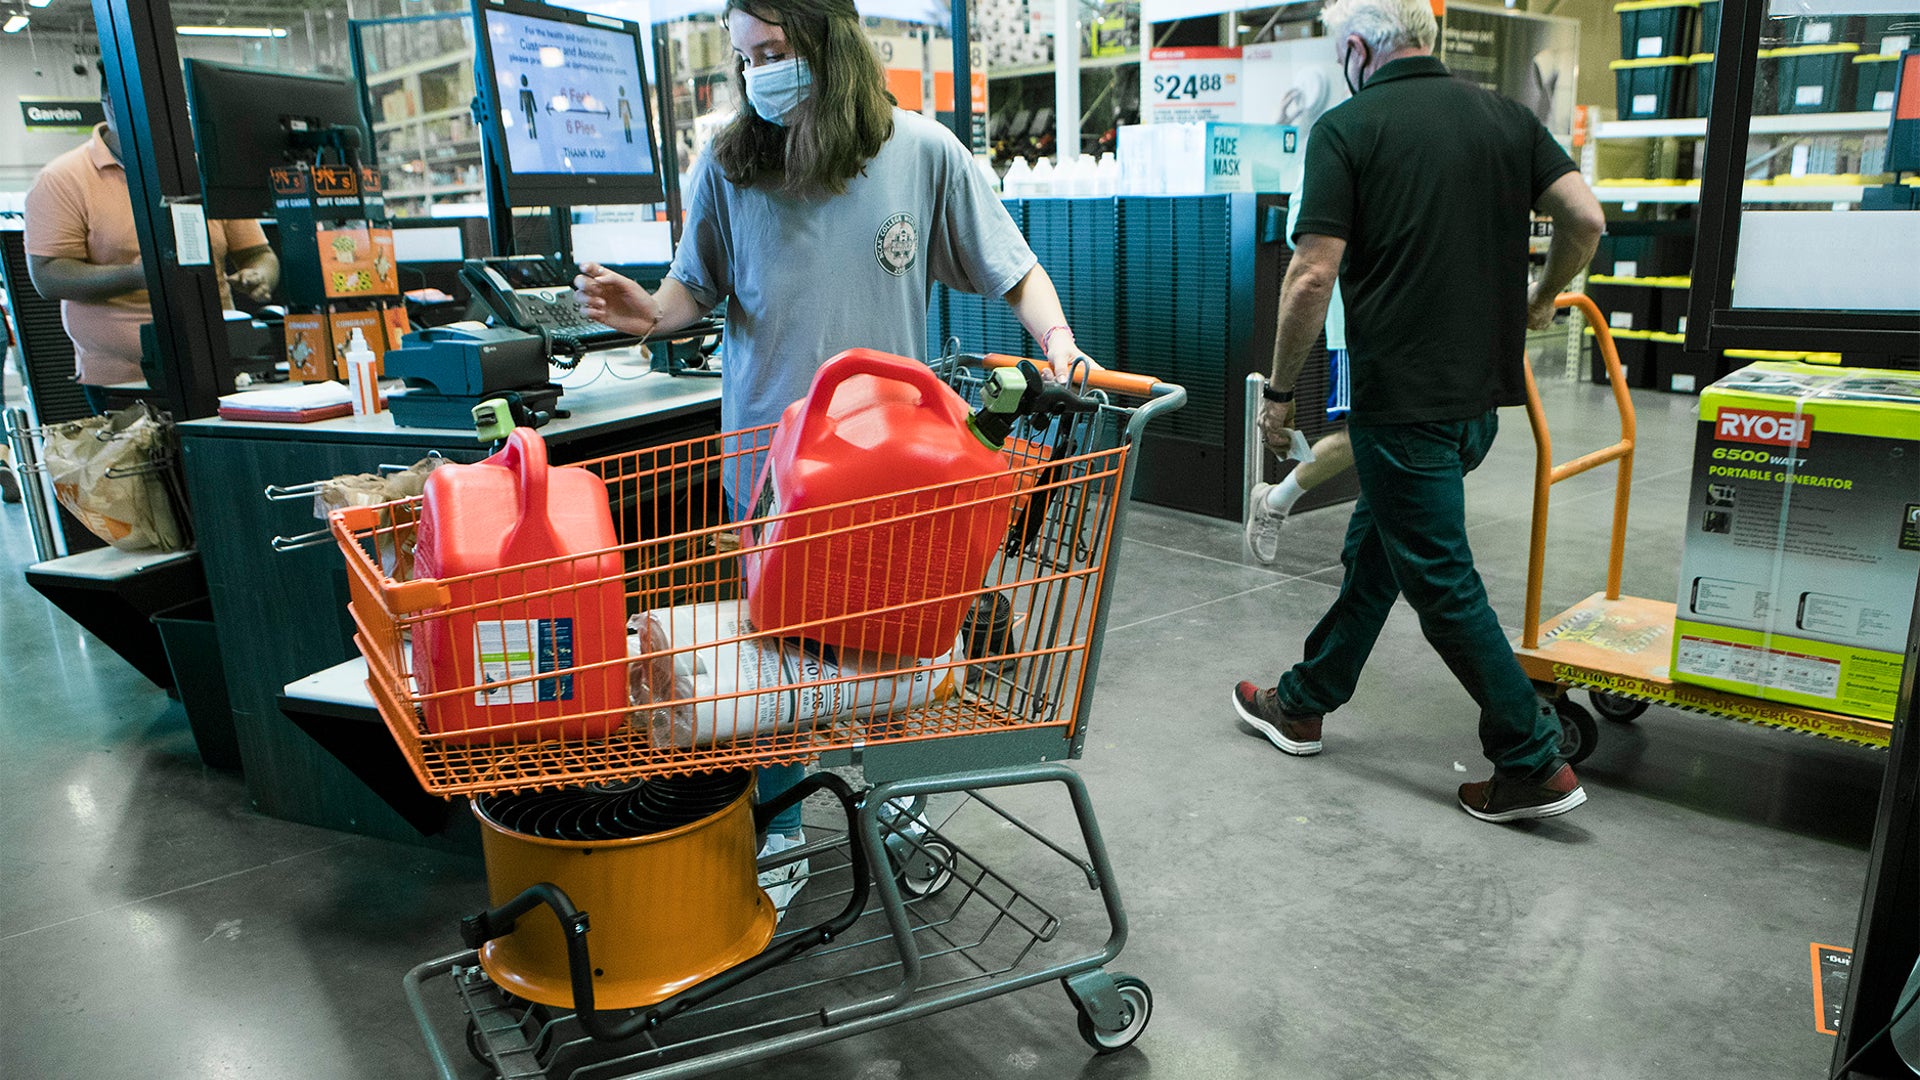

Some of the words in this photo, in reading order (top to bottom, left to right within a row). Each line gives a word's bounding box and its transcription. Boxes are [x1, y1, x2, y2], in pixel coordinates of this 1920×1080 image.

[27, 106, 83, 121] Garden
[566, 119, 573, 134] 6
[575, 120, 597, 135] Pies
[563, 147, 588, 158] THANK
[1213, 137, 1237, 155] FACE
[1213, 158, 1240, 176] MASK
[316, 197, 333, 206] GIFT
[334, 196, 360, 206] CARDS
[1721, 412, 1806, 442] RYOBI
[1712, 447, 1770, 464] 6500
[1770, 455, 1807, 467] WATT
[1709, 465, 1772, 482] PORTABLE
[1775, 471, 1853, 490] GENERATOR
[805, 661, 818, 676] 10
[812, 691, 824, 710] 25
[831, 673, 840, 711] CLEAR
[1617, 679, 1637, 690] DO
[1641, 683, 1671, 697] NOT
[1674, 690, 1706, 706] RIDE
[1713, 700, 1734, 711] OR
[1738, 704, 1822, 730] OVERLOAD
